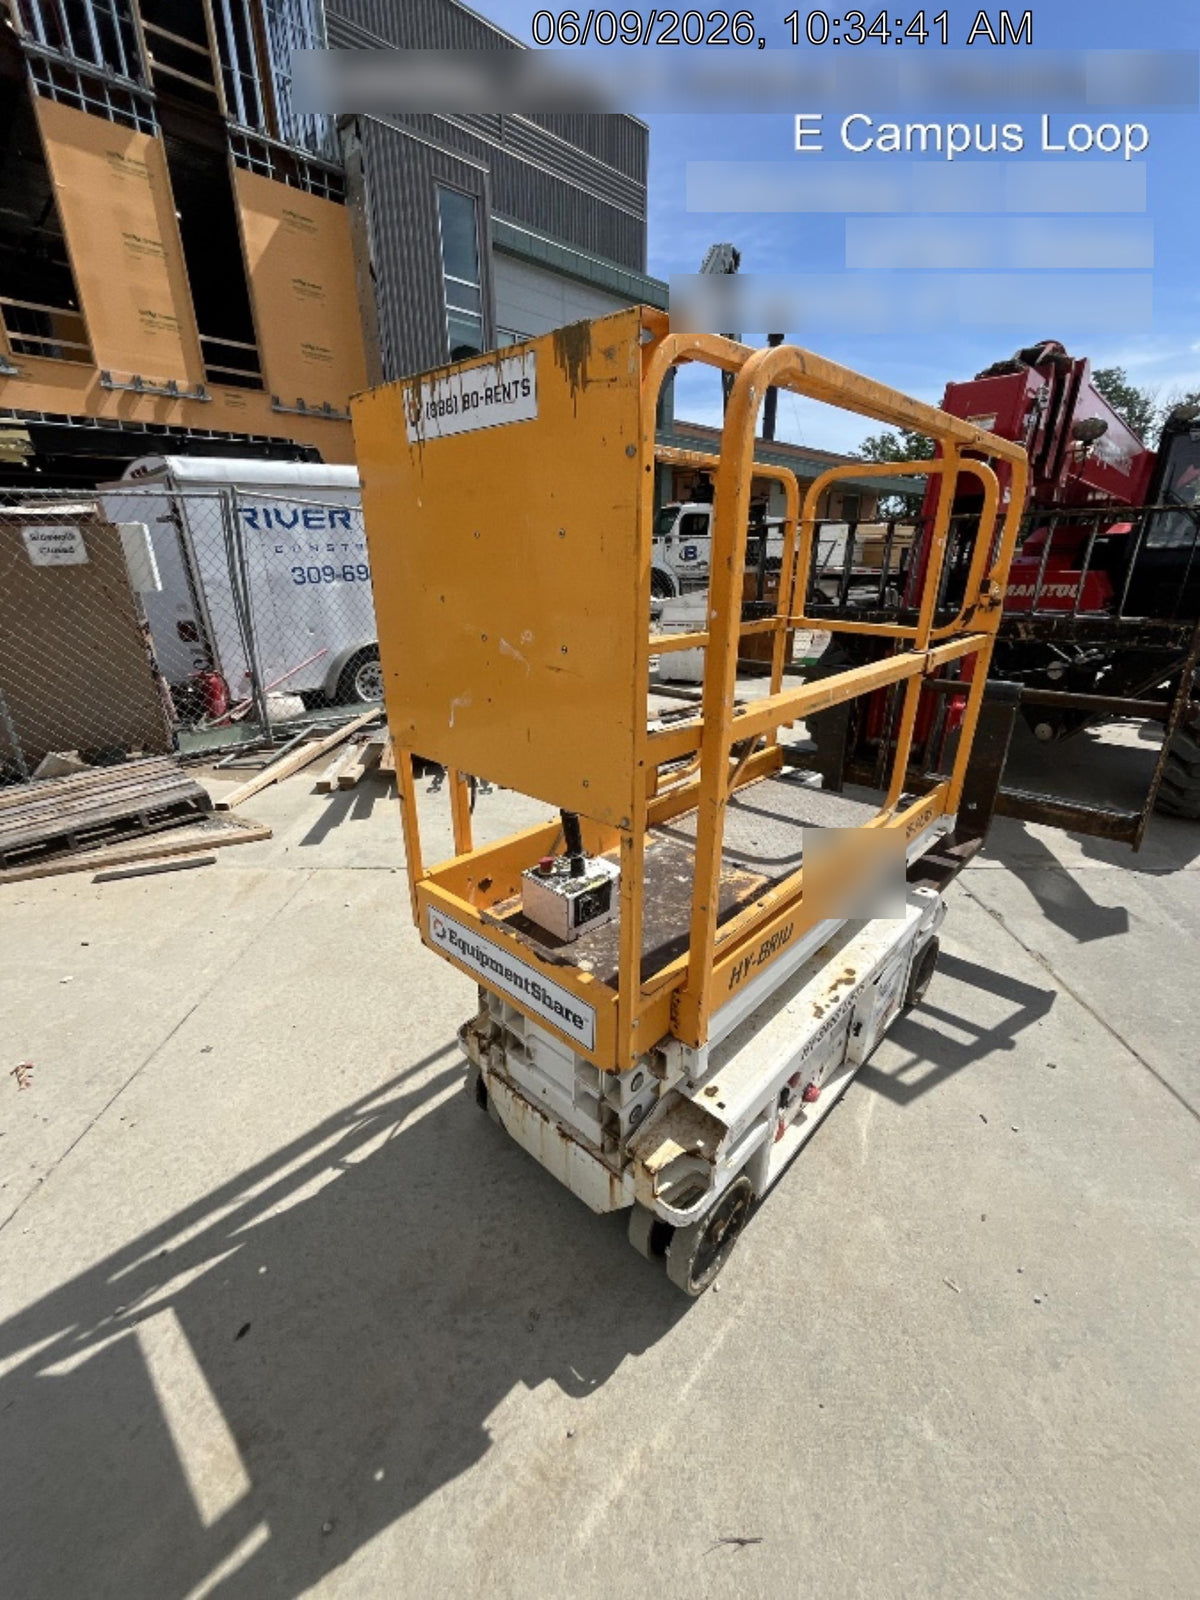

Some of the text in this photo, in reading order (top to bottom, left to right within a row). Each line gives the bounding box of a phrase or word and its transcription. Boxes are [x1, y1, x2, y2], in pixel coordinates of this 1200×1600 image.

[462, 378, 531, 414] BO-RENTS
[237, 508, 352, 530] RIVER
[449, 927, 584, 1030] EquipmentShare
